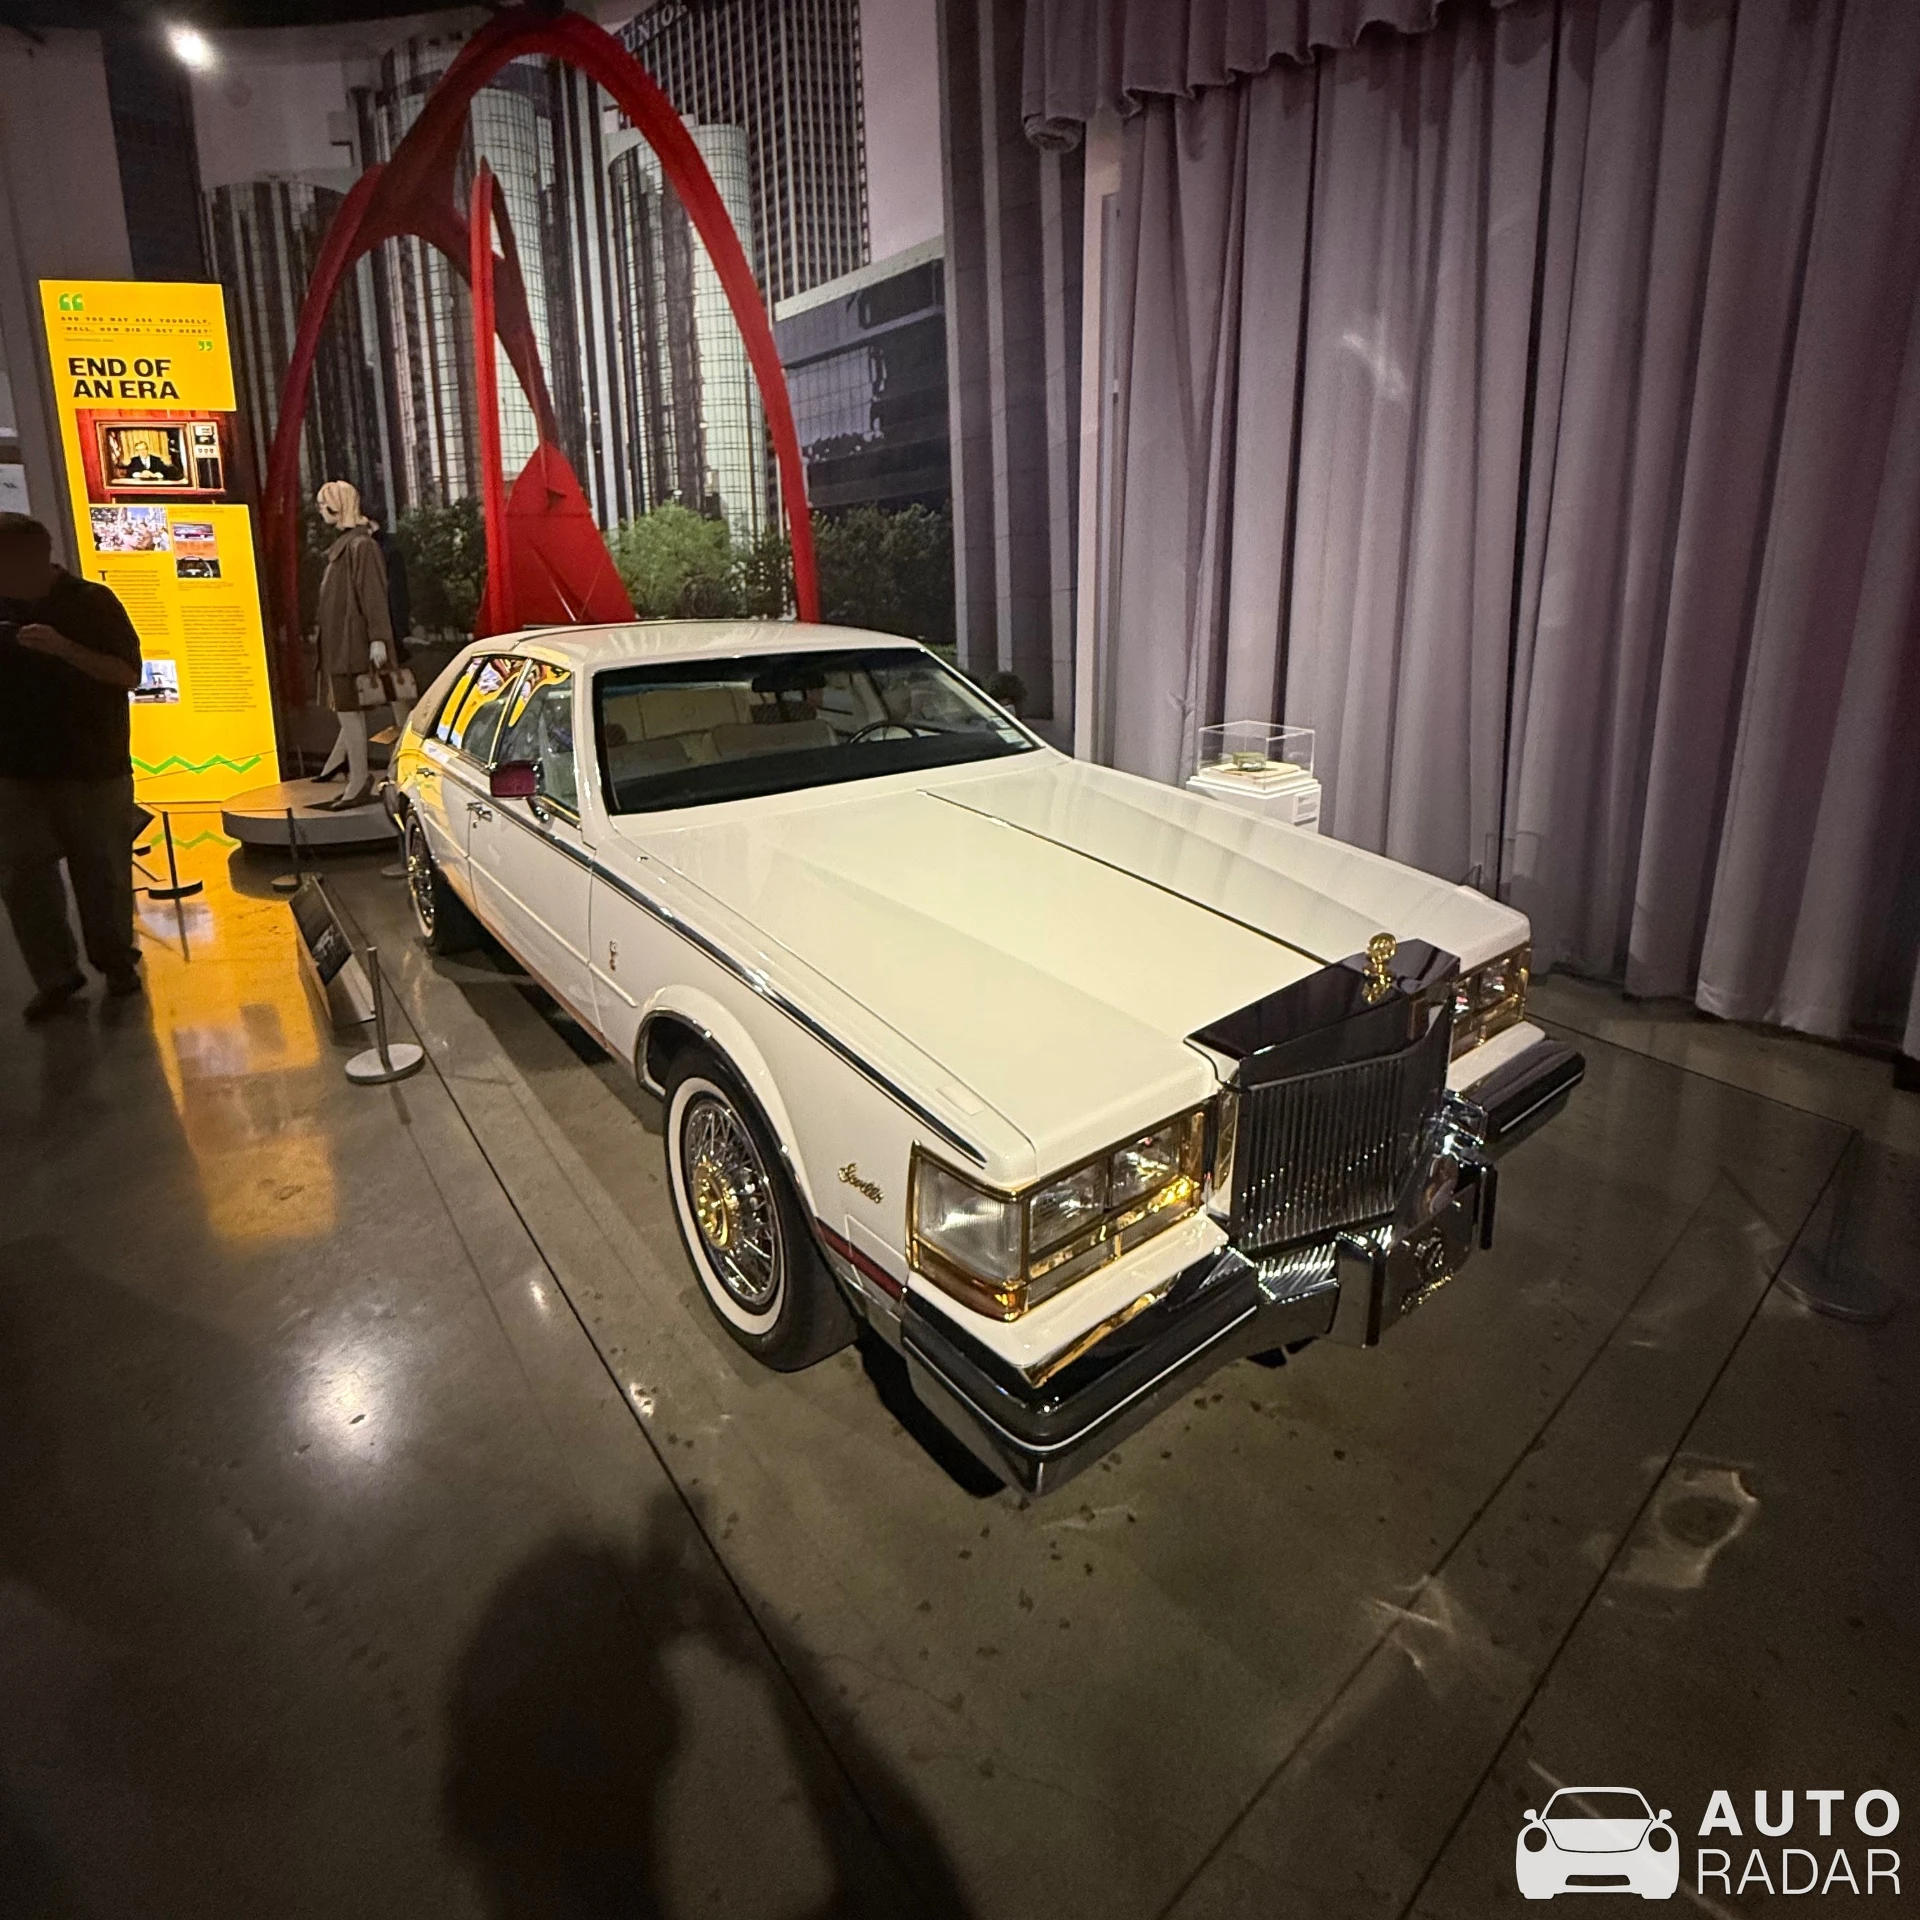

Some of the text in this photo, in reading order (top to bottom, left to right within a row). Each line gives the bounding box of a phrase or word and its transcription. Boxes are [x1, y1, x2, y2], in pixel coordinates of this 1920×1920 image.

[68, 357, 171, 377] END OF
[73, 379, 180, 400] AN ERA
